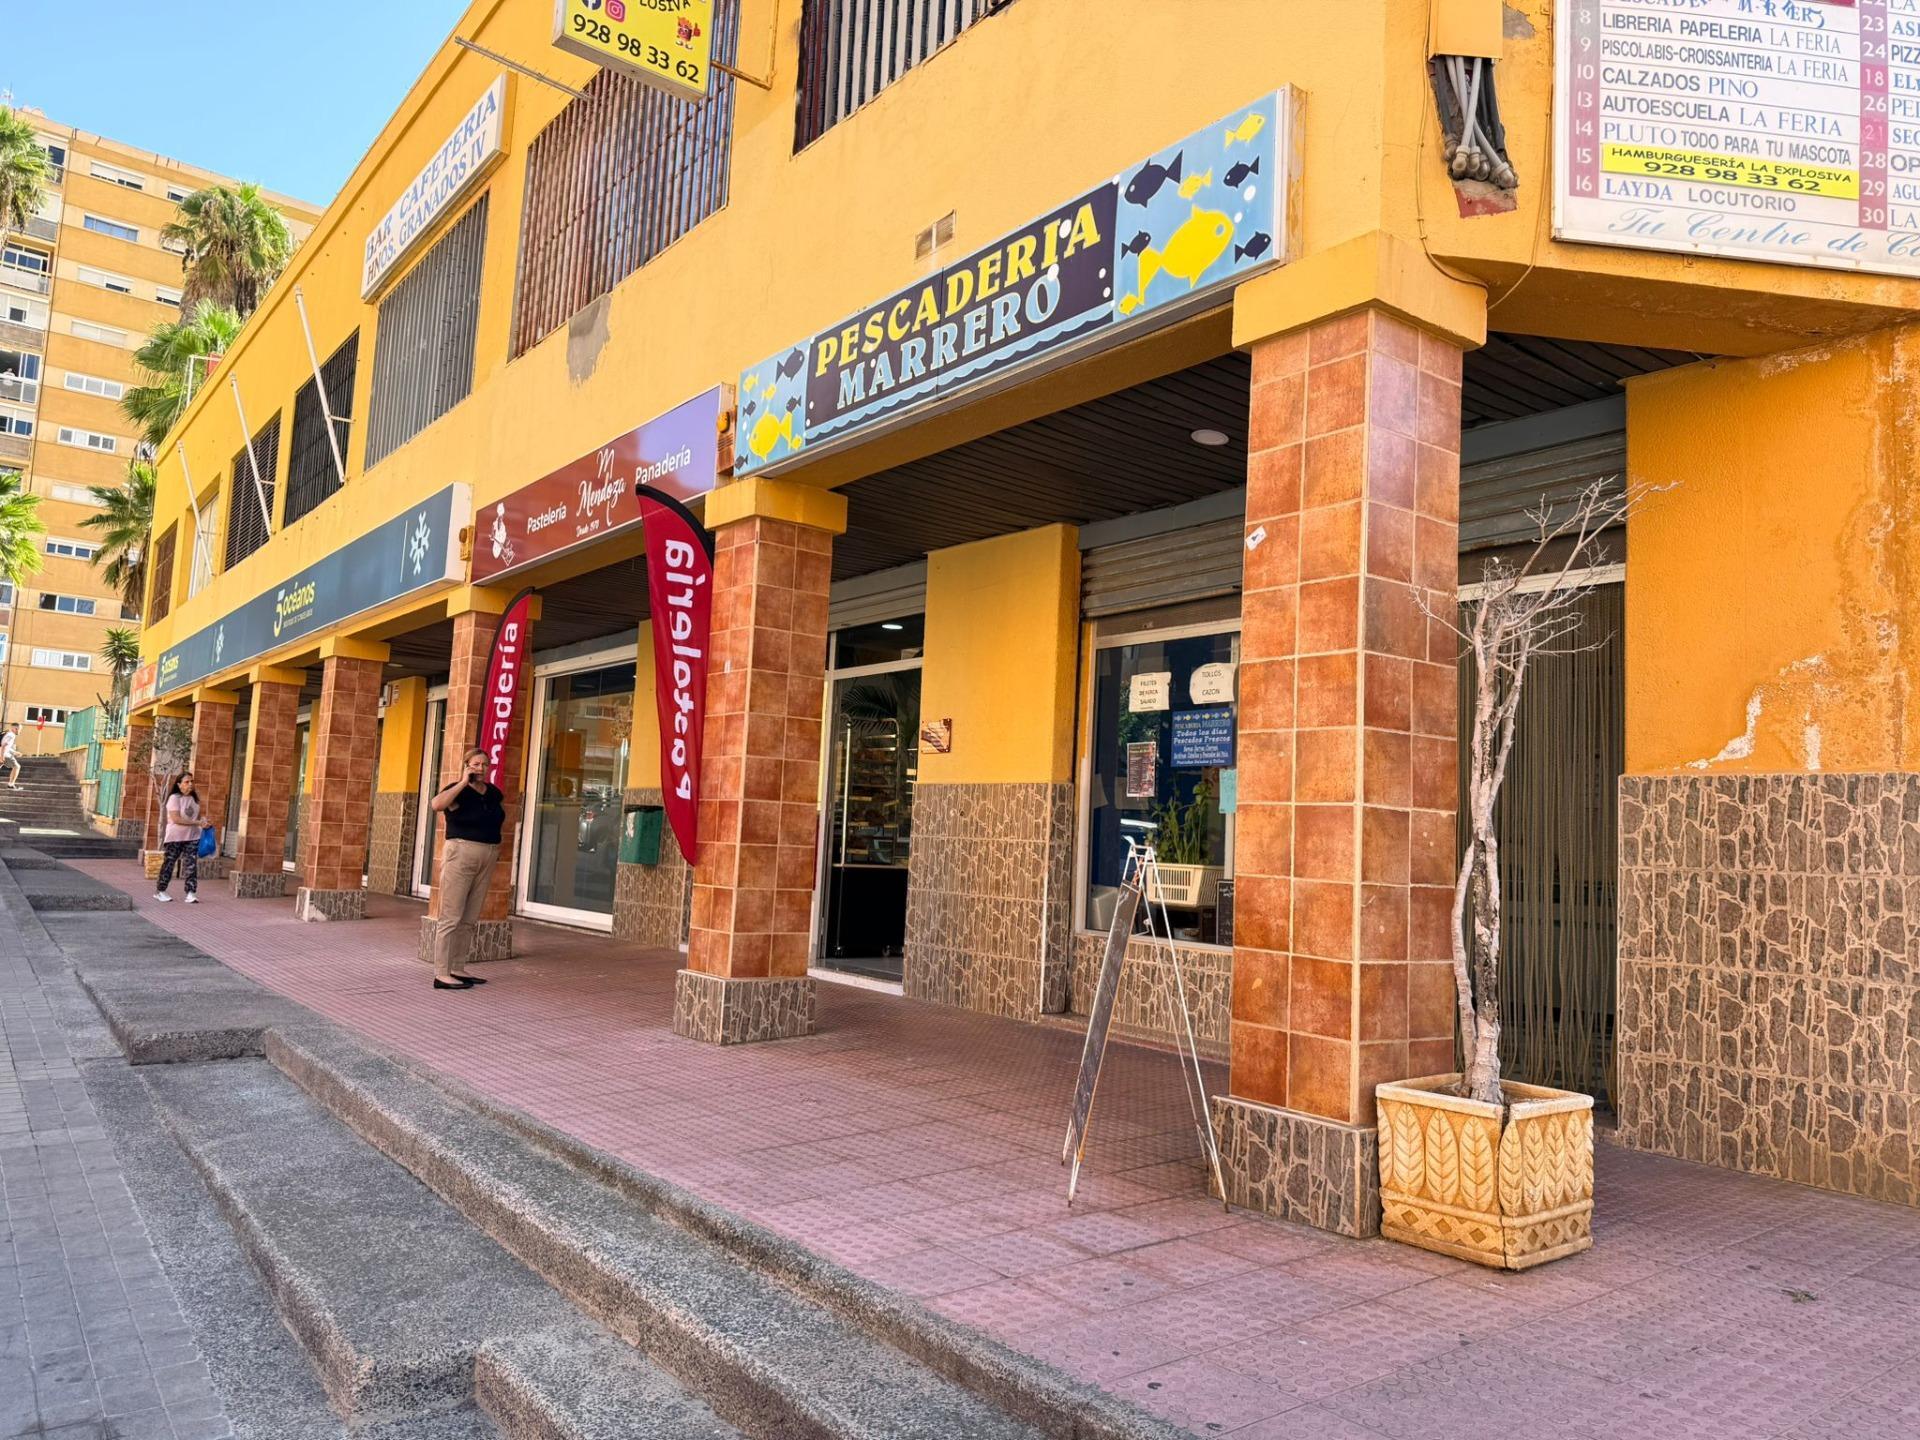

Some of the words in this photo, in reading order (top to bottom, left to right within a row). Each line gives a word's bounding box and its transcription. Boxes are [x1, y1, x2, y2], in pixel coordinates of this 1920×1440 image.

[1580, 9, 1591, 24] 8
[1602, 13, 1672, 33] LIBRERIA
[1680, 20, 1762, 43] PAPELERIA
[1770, 28, 1790, 47] LA
[1796, 32, 1841, 54] FERIA
[1862, 15, 1885, 32] 23
[1892, 20, 1920, 37] AS
[573, 14, 611, 44] 928
[617, 33, 641, 57] 98
[646, 46, 670, 70] 33
[676, 60, 699, 83] 62
[1580, 37, 1591, 52] 9
[1602, 39, 1773, 72] PISCOLABIS-CROISSANTERIA
[1777, 56, 1797, 76] LA
[1804, 60, 1848, 82] FERIA
[1863, 41, 1886, 59] 24
[1577, 63, 1594, 80] 10
[1602, 67, 1700, 91] CALZADOS
[1708, 77, 1758, 98] PINO
[1865, 68, 1885, 87] 18
[1577, 91, 1592, 108] 13
[1602, 95, 1729, 122] AUTOESCUELA
[1740, 107, 1767, 127] LA
[1779, 112, 1842, 136] FERIA
[1863, 94, 1887, 112] 26
[1575, 120, 1592, 136] 14
[1603, 122, 1676, 145] PLUTO
[1681, 130, 1718, 150] TODO
[1725, 133, 1759, 154] PARA
[1766, 140, 1783, 157] TU
[1789, 142, 1851, 165] MASCOTA
[1862, 151, 1886, 168] 28
[366, 213, 393, 263] BAR
[399, 90, 497, 219] CAFETERIA
[1576, 148, 1592, 164] 15
[1751, 162, 1768, 172] LA
[1774, 165, 1851, 183] EXPLOSIVA
[1644, 162, 1695, 176] 928
[1705, 168, 1738, 181] 98
[1747, 173, 1778, 186] 33
[1788, 179, 1821, 192] 62
[399, 153, 467, 247] GRANADOS
[471, 130, 486, 168] IV
[1576, 176, 1592, 192] 16
[1605, 179, 1673, 201] LAYDA
[1688, 188, 1796, 212] LOCUTORIO
[1862, 179, 1885, 197] 29
[1608, 208, 1665, 235] Tu
[1827, 232, 1868, 252] de
[1862, 206, 1885, 224] 30
[1891, 209, 1918, 229] LA
[816, 202, 1100, 378] PESCADERIA
[837, 275, 1061, 410] MARRERO
[635, 444, 691, 485] Panadería
[527, 501, 567, 535] Pastelería
[576, 472, 626, 526] Mendoza
[490, 622, 518, 785] nadería
